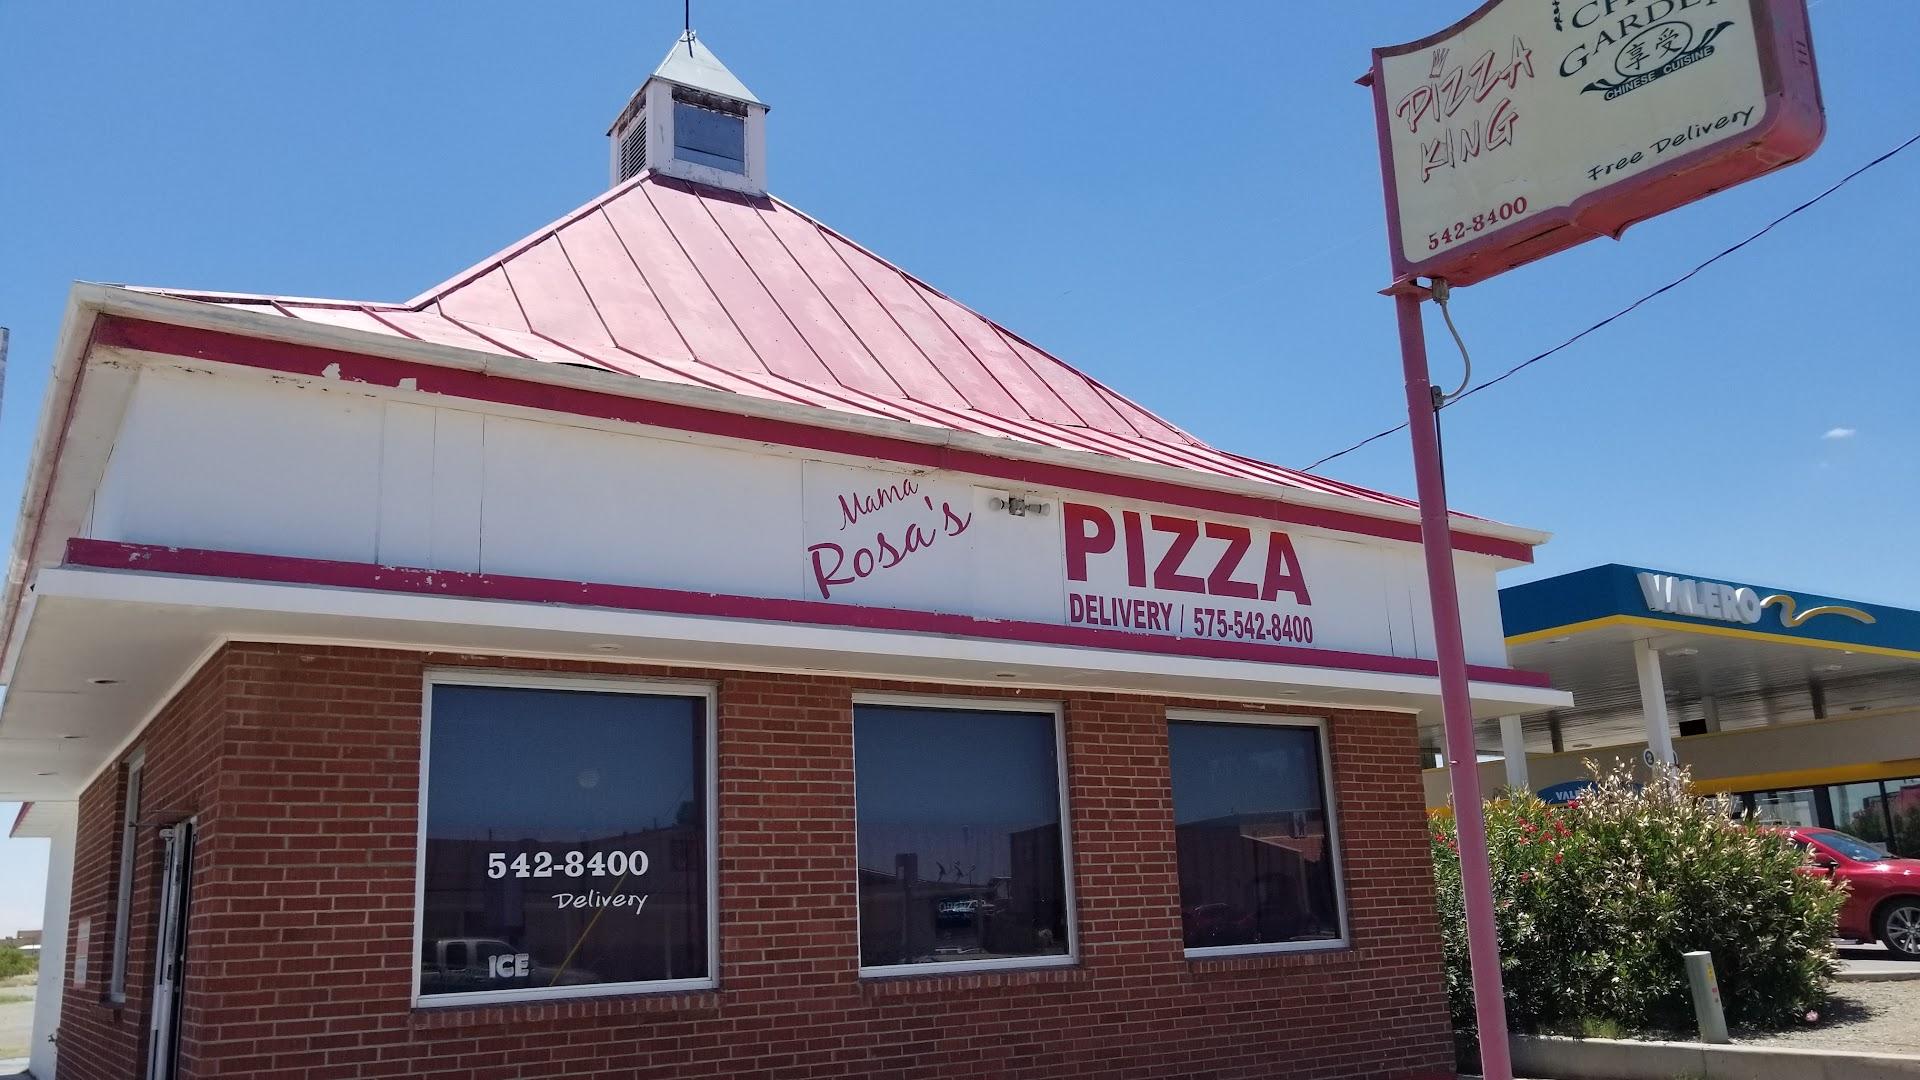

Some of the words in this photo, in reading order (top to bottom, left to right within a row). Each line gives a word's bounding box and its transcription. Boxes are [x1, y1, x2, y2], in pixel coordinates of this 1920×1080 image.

[1560, 0, 1717, 77] GARD
[1621, 27, 1683, 70] 享受
[1396, 34, 1534, 133] PIZZA
[1605, 71, 1656, 100] CHINESE
[1662, 46, 1713, 74] CUISINE
[1421, 97, 1519, 183] KING
[1587, 151, 1644, 181] Free
[1649, 106, 1754, 154] Delivery
[1428, 196, 1527, 250] 542-8400
[838, 478, 919, 531] Mama
[808, 495, 972, 599] Rosa's
[1063, 502, 1312, 606] PIZZA
[1069, 593, 1173, 631] DELIVERY
[1193, 607, 1313, 644] 575-542-8400
[1637, 571, 1761, 624] VALERO
[1555, 789, 1581, 801] VAL
[488, 850, 649, 879] 542-8400
[552, 889, 648, 915] Delivery
[488, 953, 530, 978] ICE
